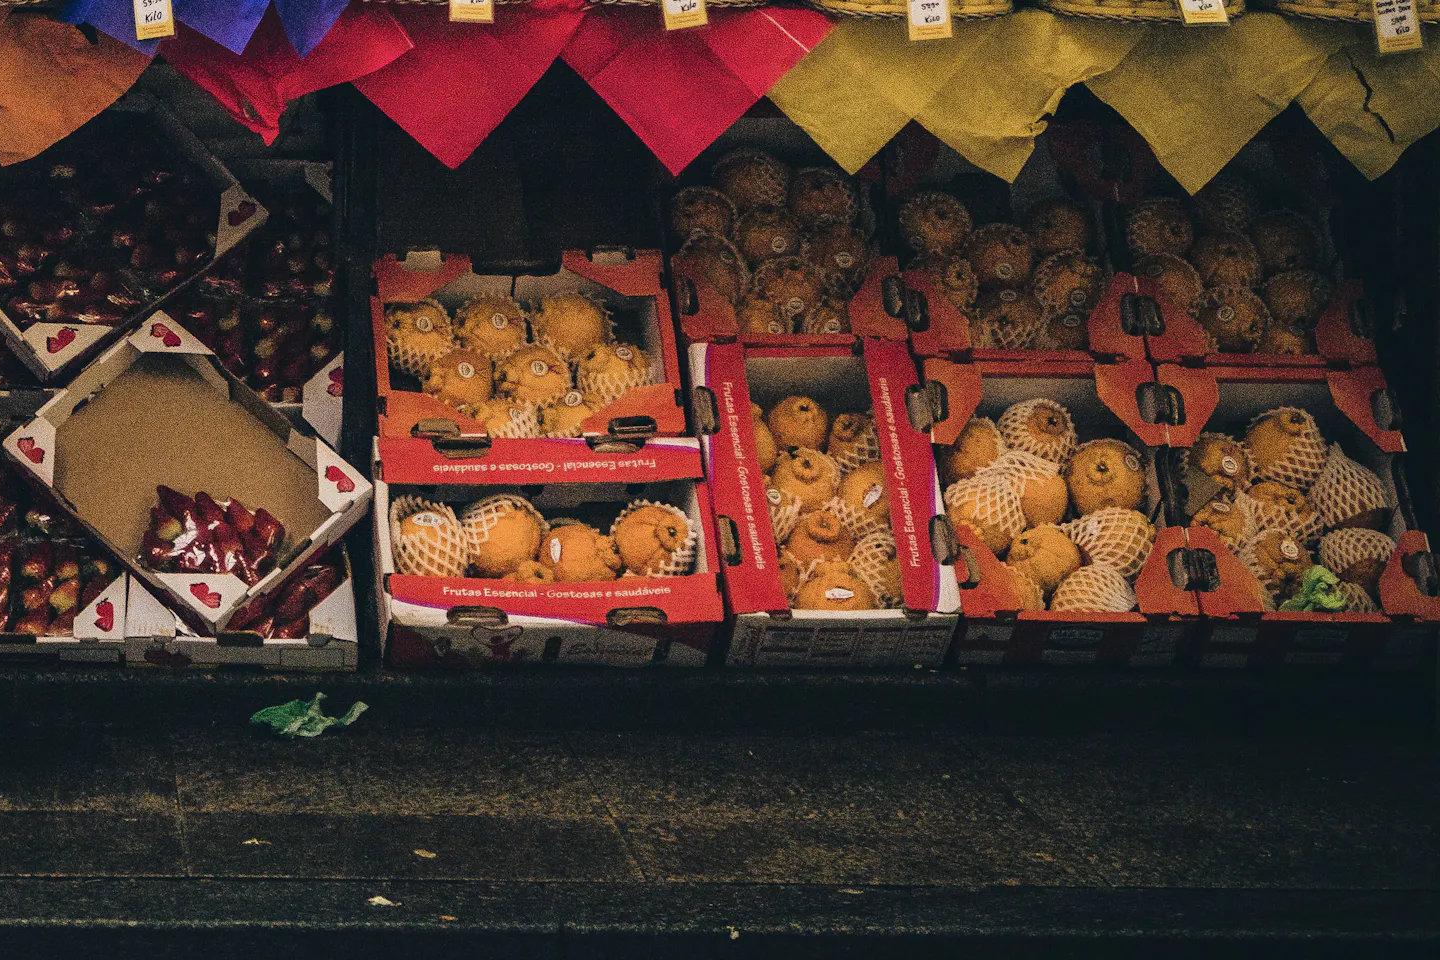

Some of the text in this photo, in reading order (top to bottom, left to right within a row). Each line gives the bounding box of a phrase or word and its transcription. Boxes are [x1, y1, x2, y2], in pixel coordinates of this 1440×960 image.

[432, 464, 488, 476] saudáveis
[498, 462, 555, 473] Gostosas
[563, 460, 617, 472] Essencial
[619, 459, 657, 470] Frutas
[442, 586, 481, 597] Frutas
[483, 587, 538, 598] Essencial
[546, 588, 602, 599] Gostosas
[614, 585, 671, 598] saudáveis
